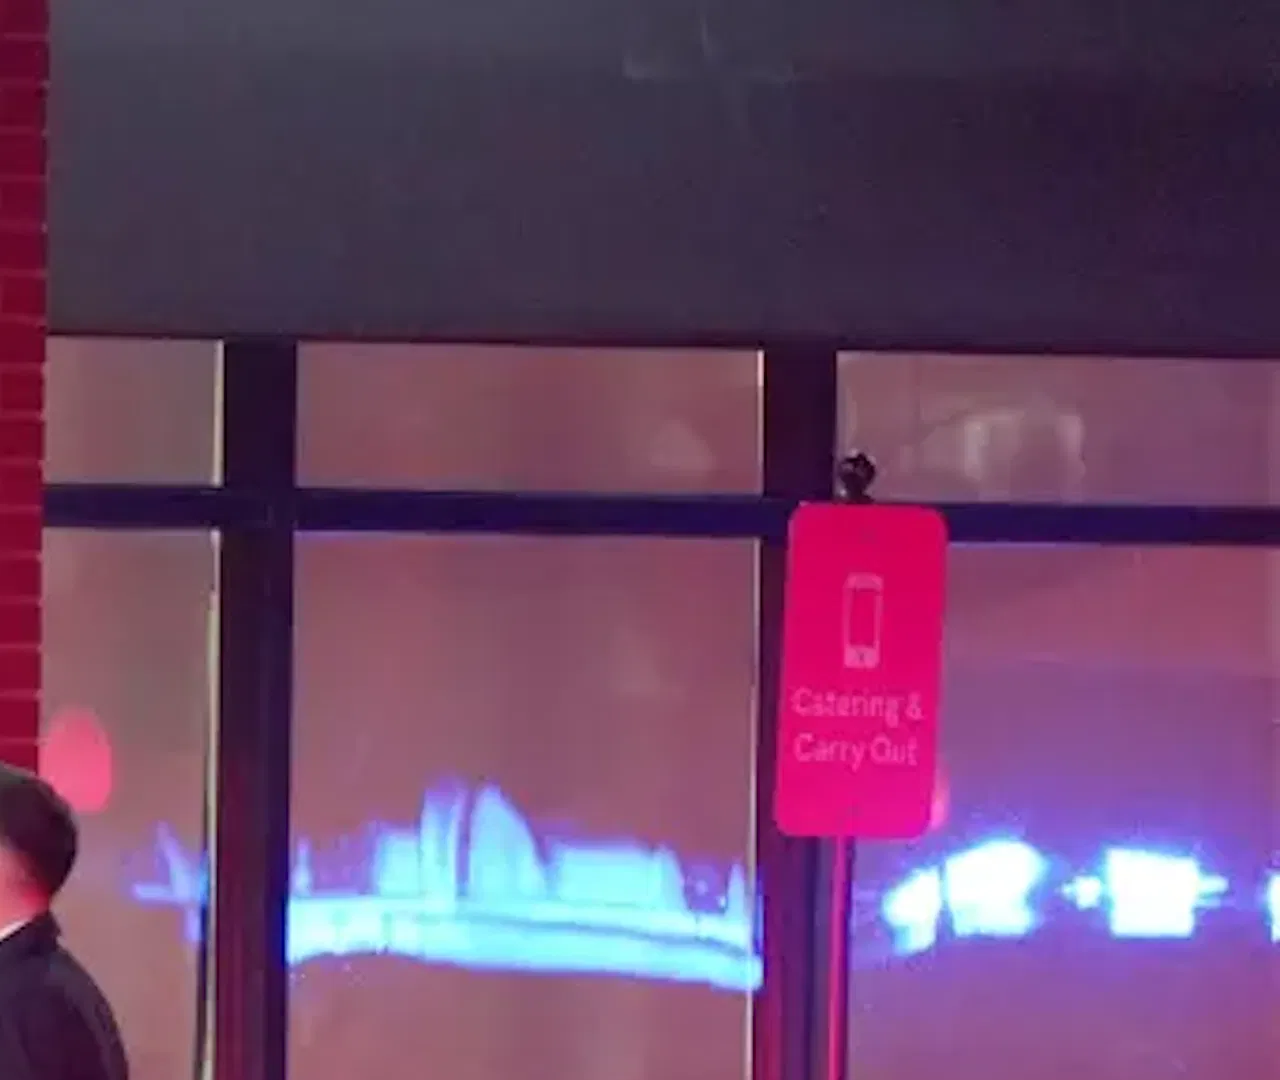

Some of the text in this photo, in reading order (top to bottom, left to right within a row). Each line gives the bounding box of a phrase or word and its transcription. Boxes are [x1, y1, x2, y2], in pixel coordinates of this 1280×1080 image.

[791, 687, 927, 728] Catering &
[794, 732, 918, 773] Carry Out
